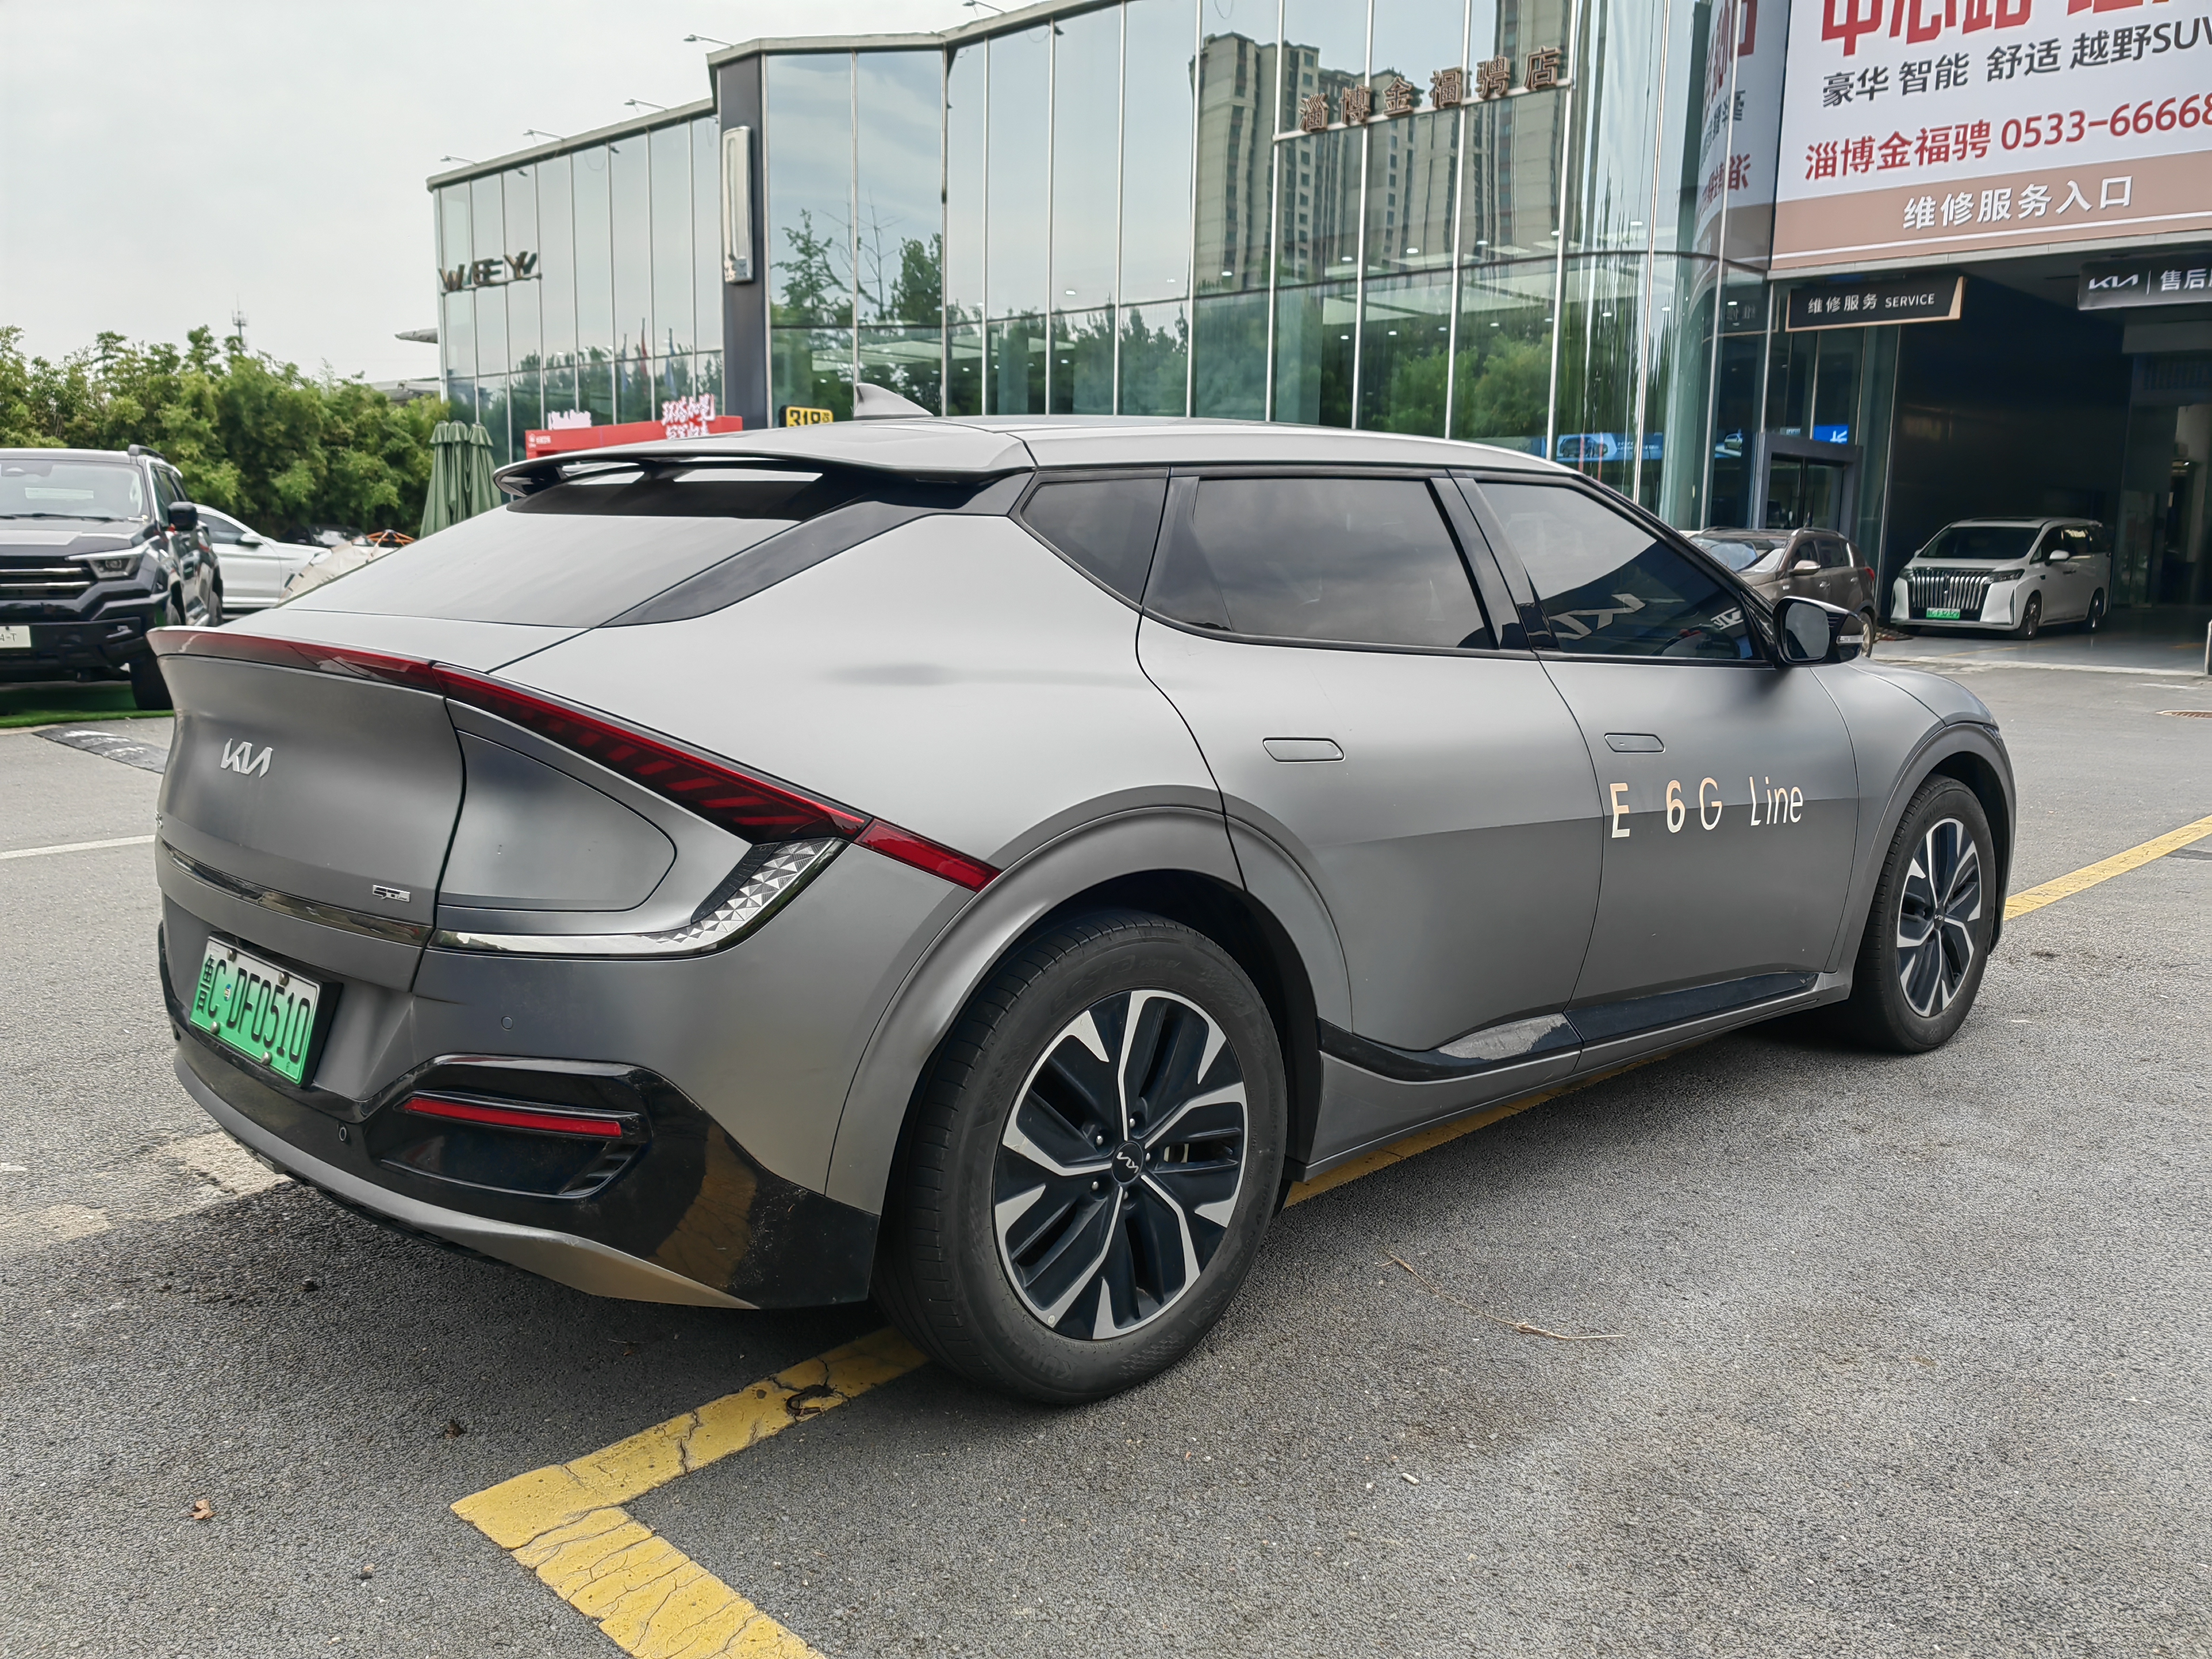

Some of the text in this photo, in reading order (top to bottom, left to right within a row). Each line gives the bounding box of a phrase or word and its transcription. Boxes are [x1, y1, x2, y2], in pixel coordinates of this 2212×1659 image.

[1823, 66, 1889, 107] 豪华
[1899, 52, 1969, 96] 智能
[1987, 38, 2061, 82] 舒适
[1805, 118, 1991, 180] 淄博金福骋
[1903, 176, 2133, 230] 维修服务入口
[1808, 293, 1935, 314] 维修服务 SERVICE
[2161, 268, 2212, 292] 售后
[220, 738, 273, 778] KIA
[1749, 776, 1803, 826] Line
